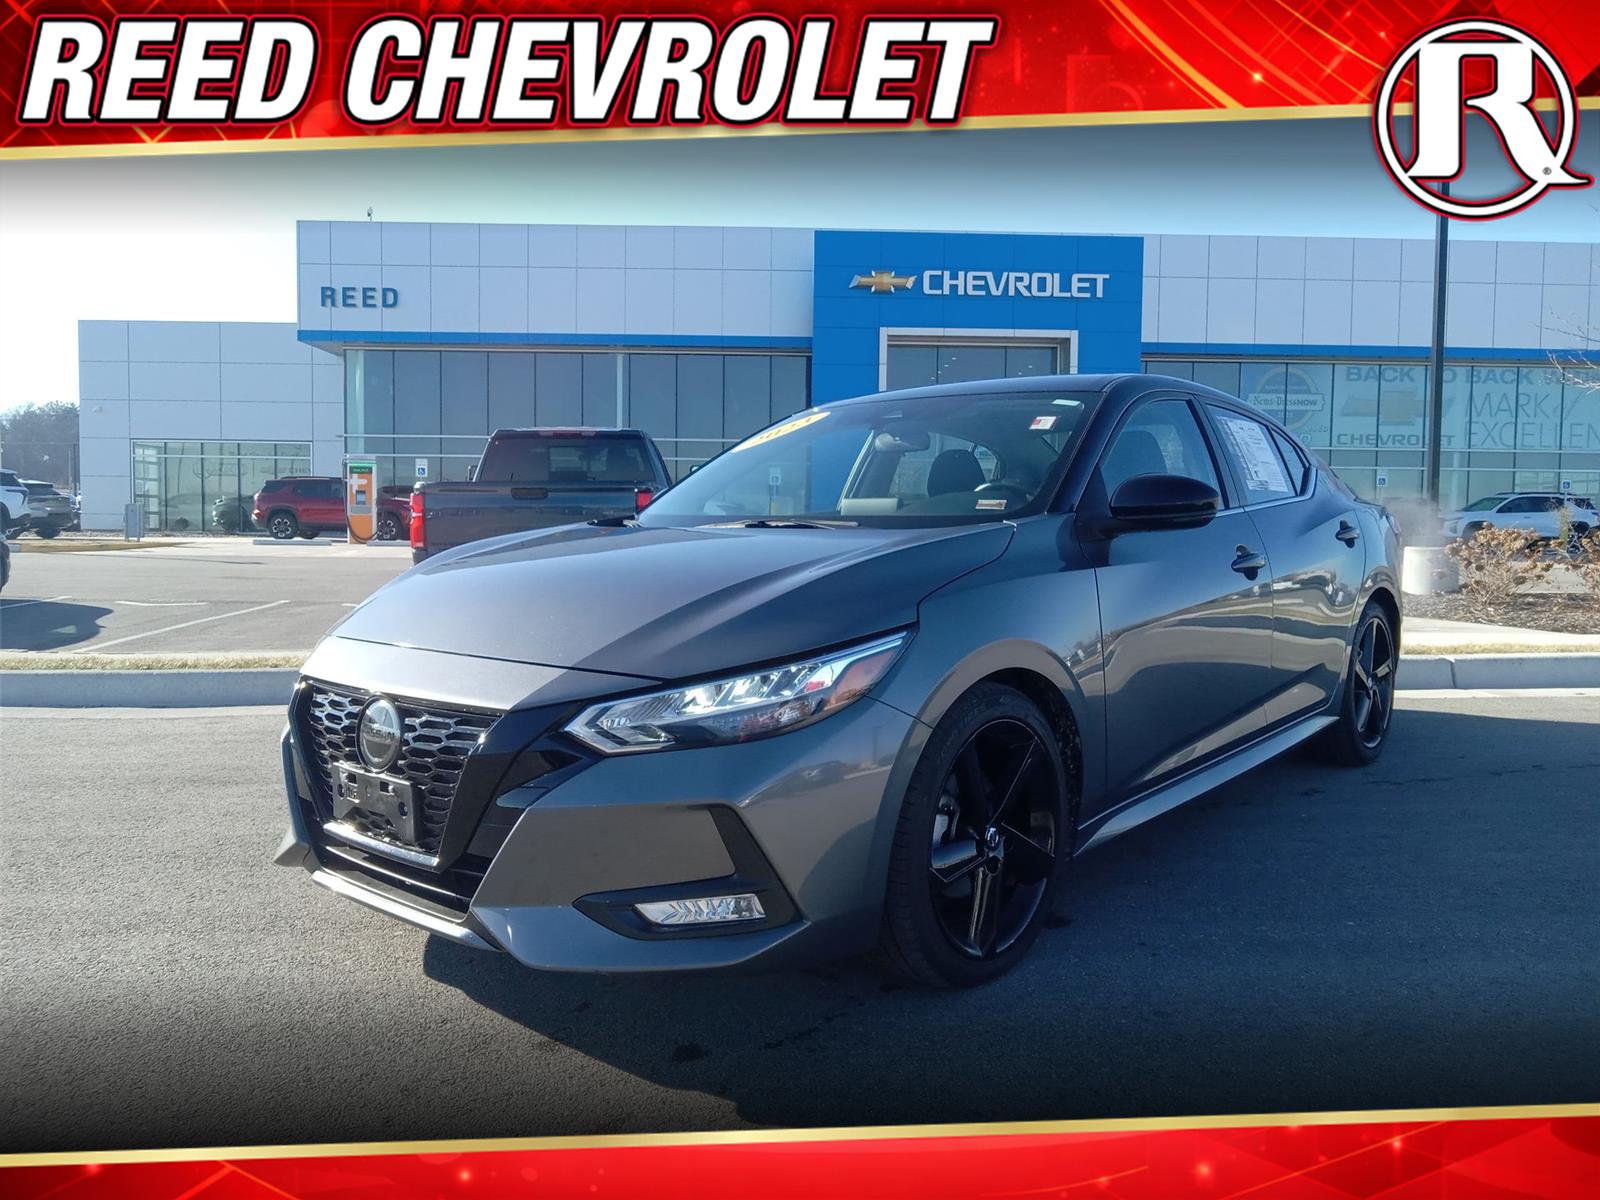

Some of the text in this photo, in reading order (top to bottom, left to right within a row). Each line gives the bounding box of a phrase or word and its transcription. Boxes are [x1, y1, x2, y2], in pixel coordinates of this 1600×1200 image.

[922, 270, 1110, 298] CHEVROLET
[320, 286, 399, 308] REED
[1346, 366, 1415, 383] BACK
[1465, 368, 1535, 385] BACK
[1464, 391, 1550, 420] MARK
[1336, 433, 1456, 447] CHEVROET
